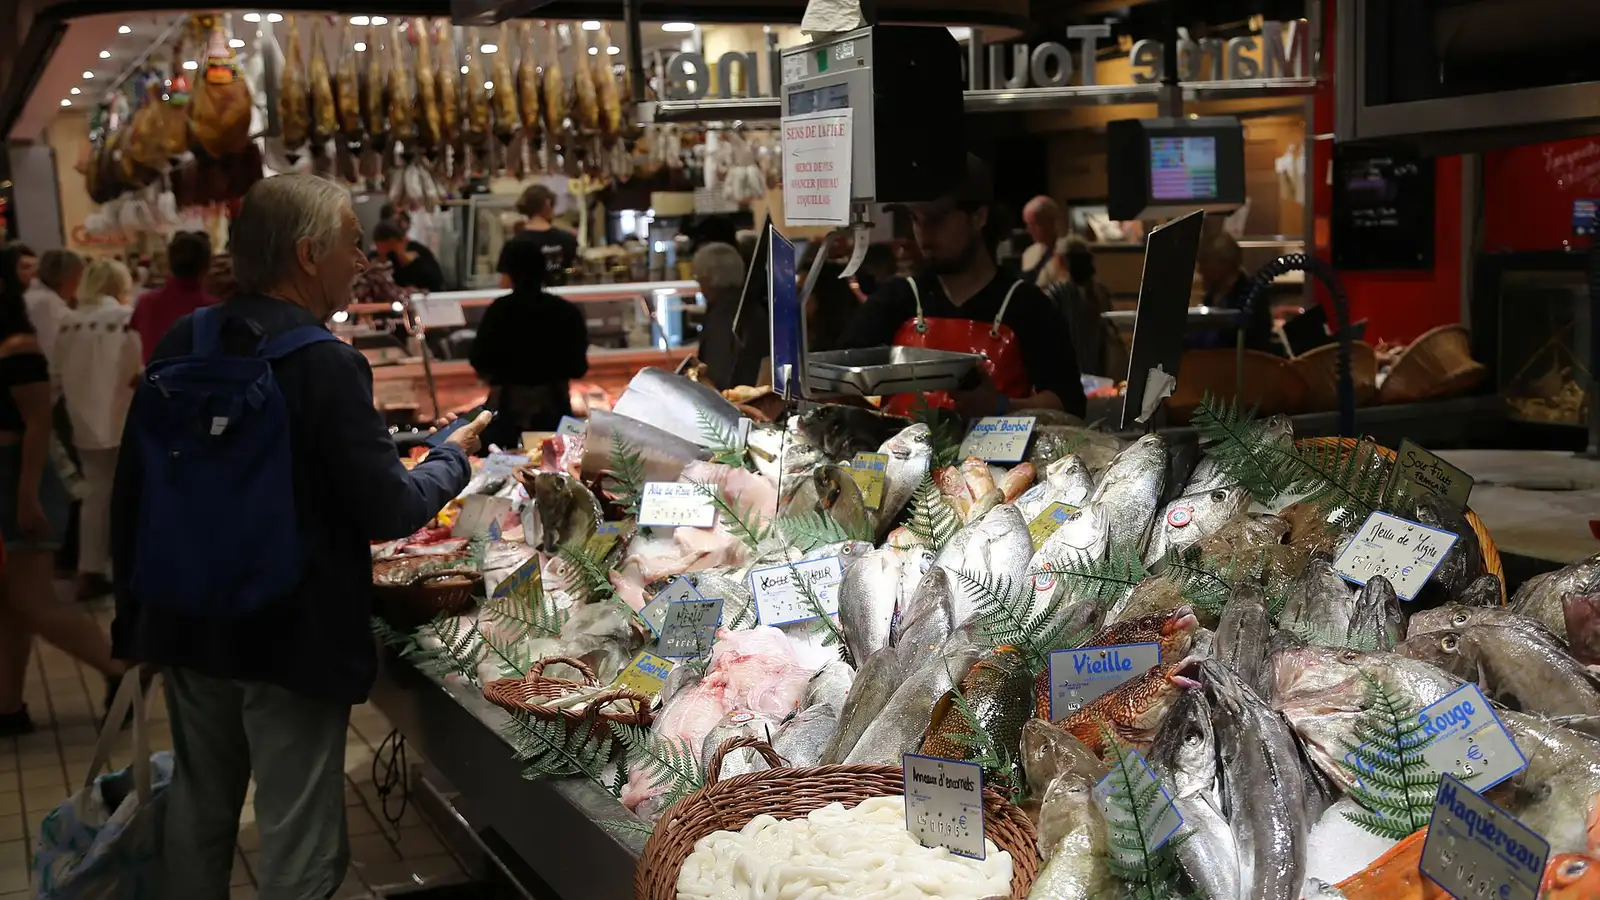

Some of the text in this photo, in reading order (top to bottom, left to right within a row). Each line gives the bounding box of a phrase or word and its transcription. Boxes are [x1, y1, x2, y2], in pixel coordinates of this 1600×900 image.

[787, 126, 804, 140] SENS
[805, 125, 817, 139] DE
[1397, 534, 1409, 545] de
[1402, 566, 1413, 577] €
[1073, 651, 1133, 675] Vieille
[1418, 700, 1477, 738] Rouge
[1467, 744, 1484, 760] €
[959, 815, 968, 830] €
[1438, 782, 1541, 874] Maquereau
